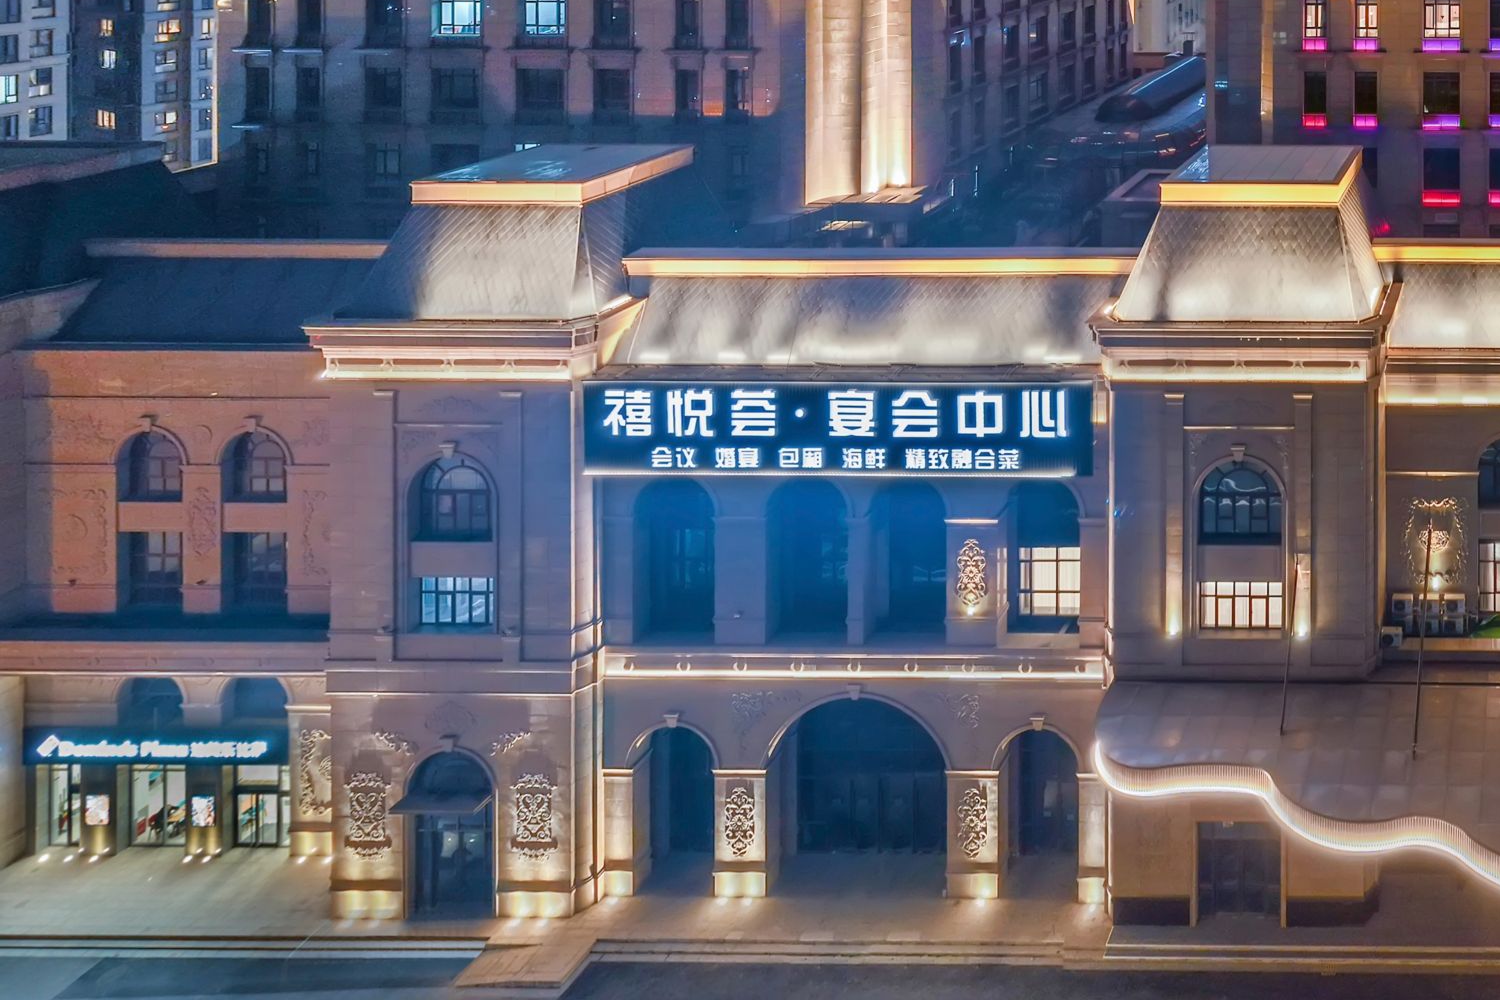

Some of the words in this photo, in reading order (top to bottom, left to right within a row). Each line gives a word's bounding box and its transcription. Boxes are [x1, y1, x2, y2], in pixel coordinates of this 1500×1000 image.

[603, 388, 1068, 438] 禧悦荟·宴会中心
[650, 447, 697, 469] 会议
[715, 447, 760, 469] 婚宴
[778, 447, 823, 469] 包厢
[842, 448, 887, 470] 海鲜
[904, 448, 1020, 470] 精致融合菜
